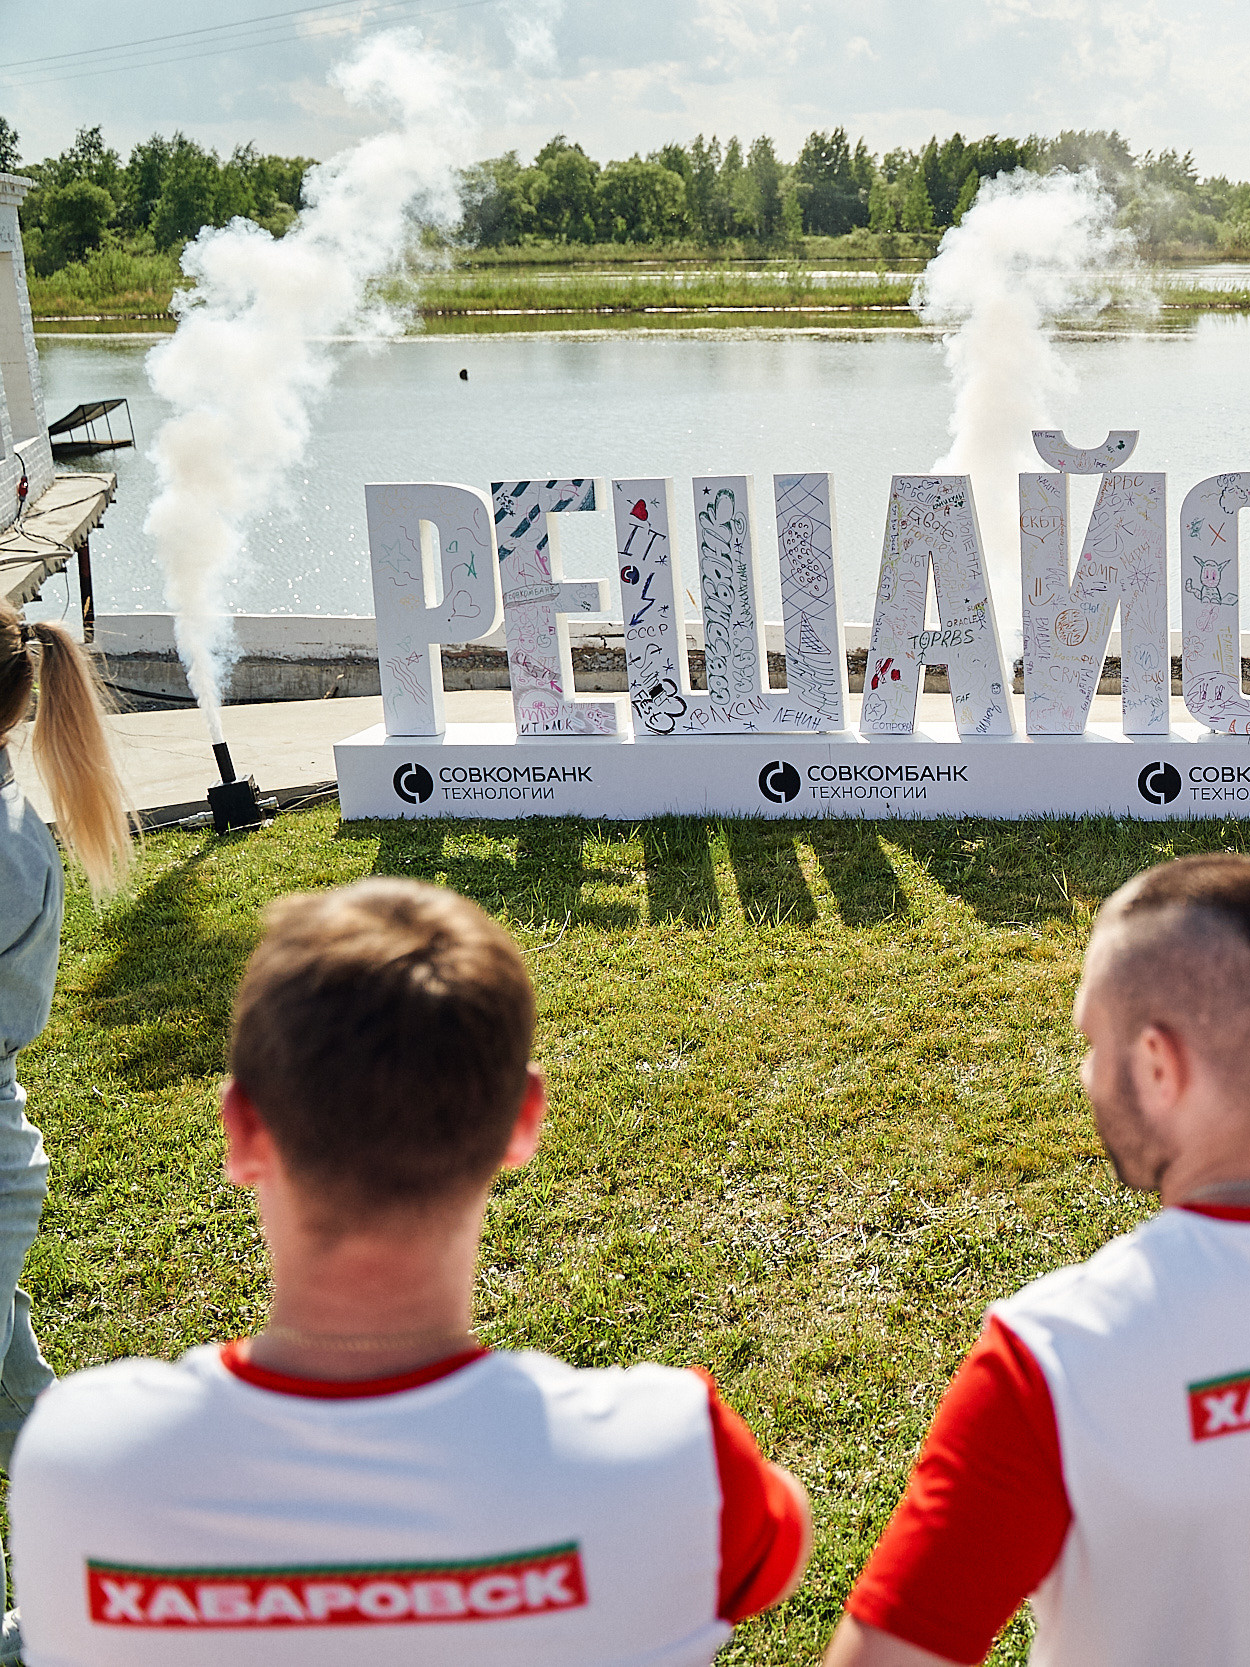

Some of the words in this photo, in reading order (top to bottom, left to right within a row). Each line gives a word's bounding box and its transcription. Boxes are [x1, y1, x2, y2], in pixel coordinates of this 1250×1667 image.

[1021, 515, 1060, 529] СКБТ
[947, 615, 977, 628] ORACLE
[627, 623, 669, 641] СССР
[690, 695, 770, 729] ВЛКСМ
[773, 707, 822, 730] ЛЕНИН
[439, 766, 593, 783] СОВКОМБАНК
[807, 764, 969, 782] СОВКОМБАНК
[441, 787, 555, 800] ТЕХНОЛОГИИ
[808, 787, 927, 799] ТЕХНОЛОГИИ
[101, 1564, 573, 1622] ХАБАРОВСК
